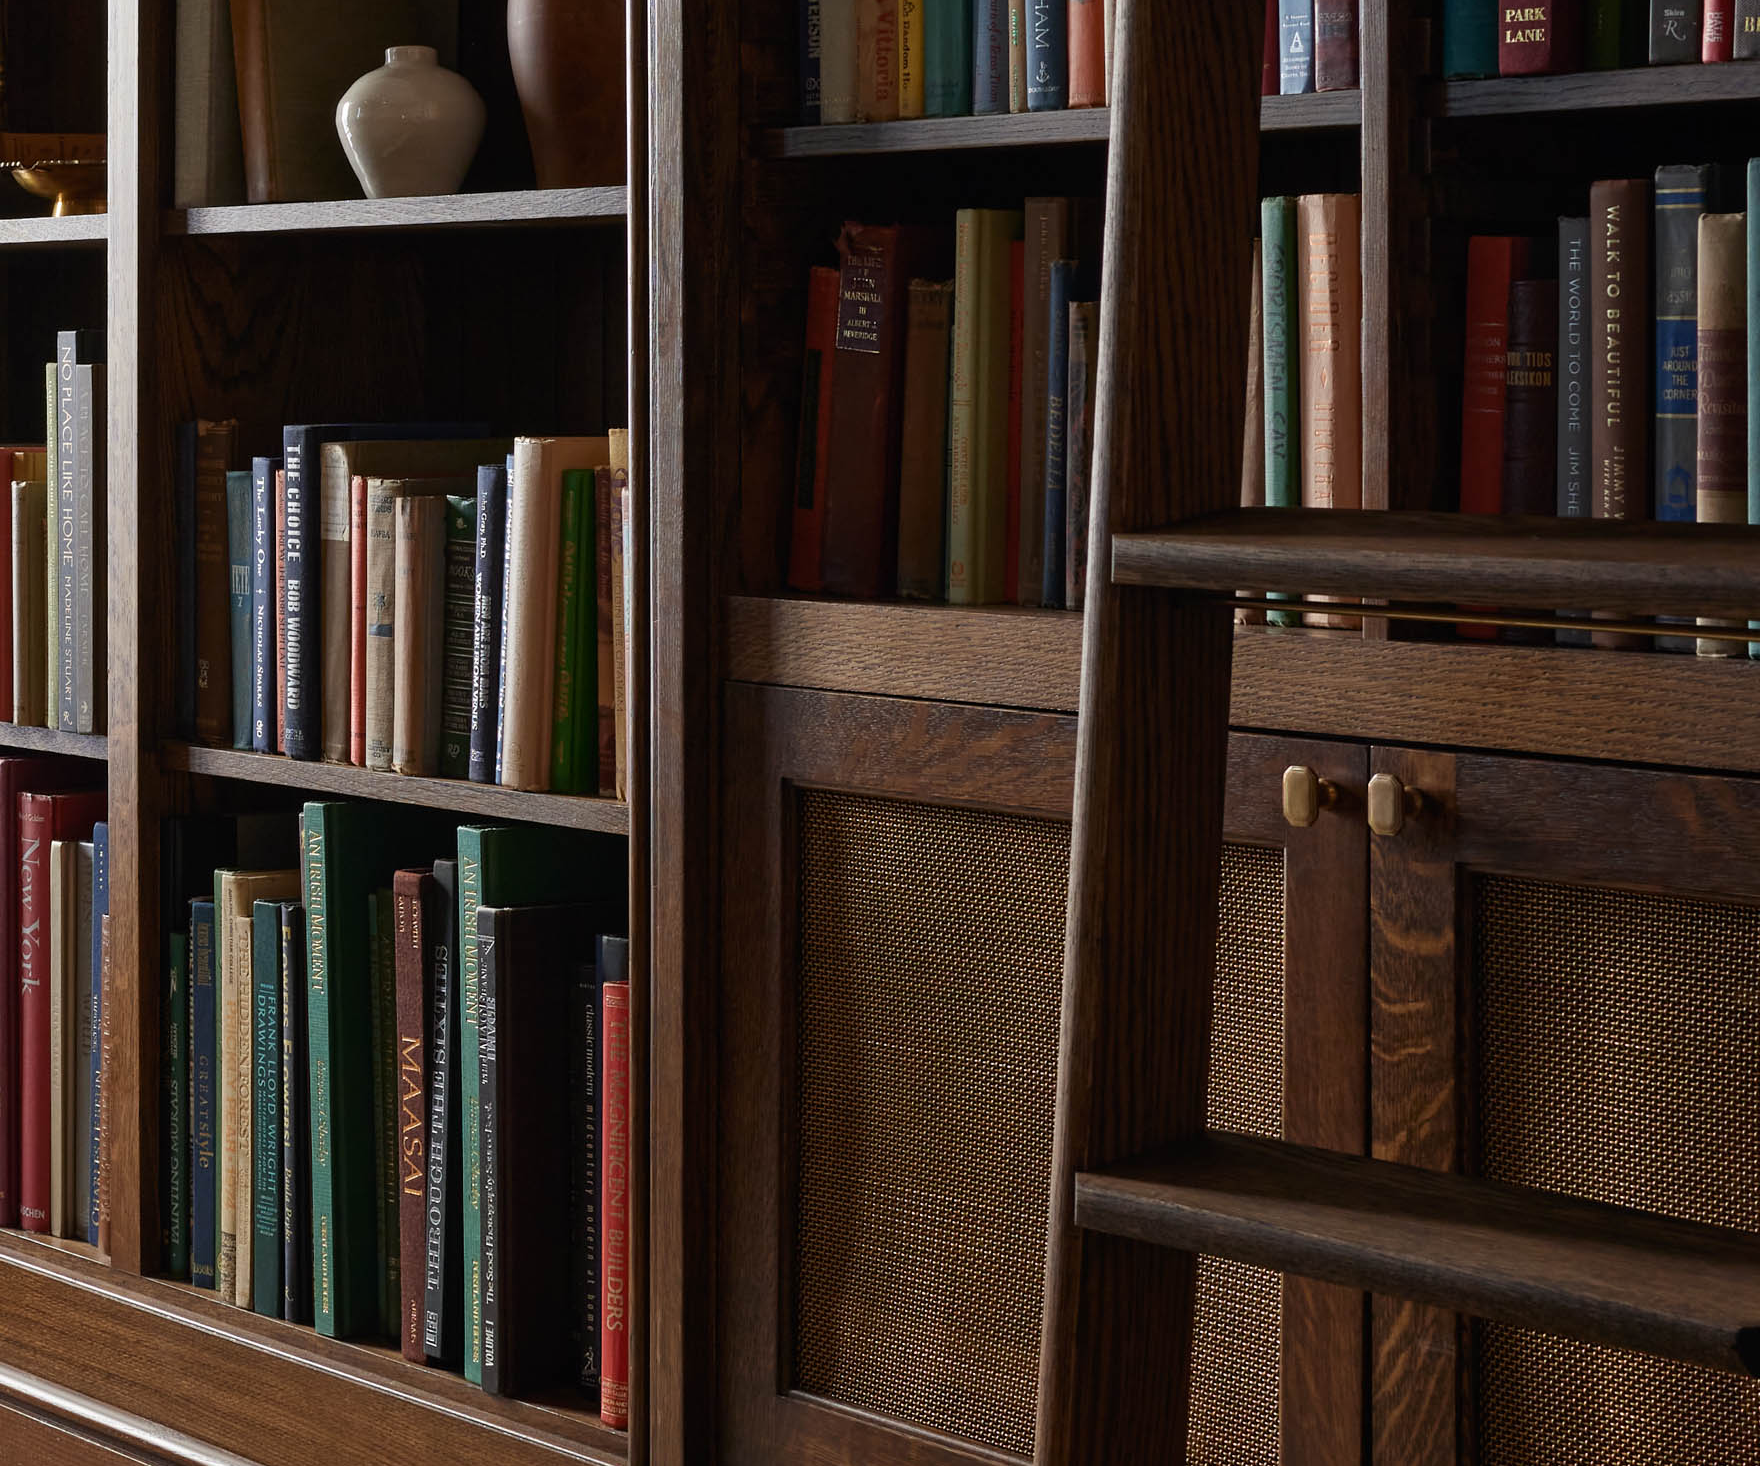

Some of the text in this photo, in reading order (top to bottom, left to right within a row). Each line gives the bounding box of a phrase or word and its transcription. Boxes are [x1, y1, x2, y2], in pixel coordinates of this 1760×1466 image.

[875, 11, 894, 102] Vittoria
[1504, 29, 1546, 44] LANE
[1505, 8, 1546, 23] PARK
[1309, 232, 1340, 353] DECIDER
[1568, 237, 1581, 431] THE WORLD TO COME
[1605, 204, 1621, 428] WALK TO BEAUTIFUL
[1662, 389, 1698, 400] CORNER
[1671, 374, 1689, 386] THE
[61, 346, 73, 568] NO PLACE LIKE HOME
[1046, 395, 1064, 489] BEDELIA
[1567, 445, 1581, 476] JIM
[1613, 445, 1625, 504] JIMMY
[79, 493, 89, 598] CALL HOME
[254, 477, 266, 577] The Lucky One
[287, 444, 301, 562] THE CHOICE
[64, 576, 73, 704] MADELINE STUART
[256, 604, 265, 661] NICHOLAS
[286, 579, 301, 709] BOB WOODWARD
[472, 571, 482, 620] WOMEN
[21, 836, 40, 998] New York
[309, 829, 326, 994] AN IRISH MOMENT
[464, 856, 478, 1026] AN IRISH MOMENT
[282, 924, 292, 1027] FLOWERS
[238, 930, 249, 1157] THE HIDDEN FOREST
[257, 993, 267, 1086] DRAWINGS
[197, 1054, 214, 1168] GREAT style
[267, 994, 277, 1193] FRANK LLOYD WRIGHT
[400, 1033, 423, 1197] MAASAI
[171, 1156, 179, 1245] PAINTING
[584, 1003, 595, 1332] classic modern modern at home
[607, 1019, 628, 1332] THE MAGNIFICENT BUILDERS
[426, 1310, 439, 1348] LIFE
[485, 1326, 495, 1366] VOLUME
